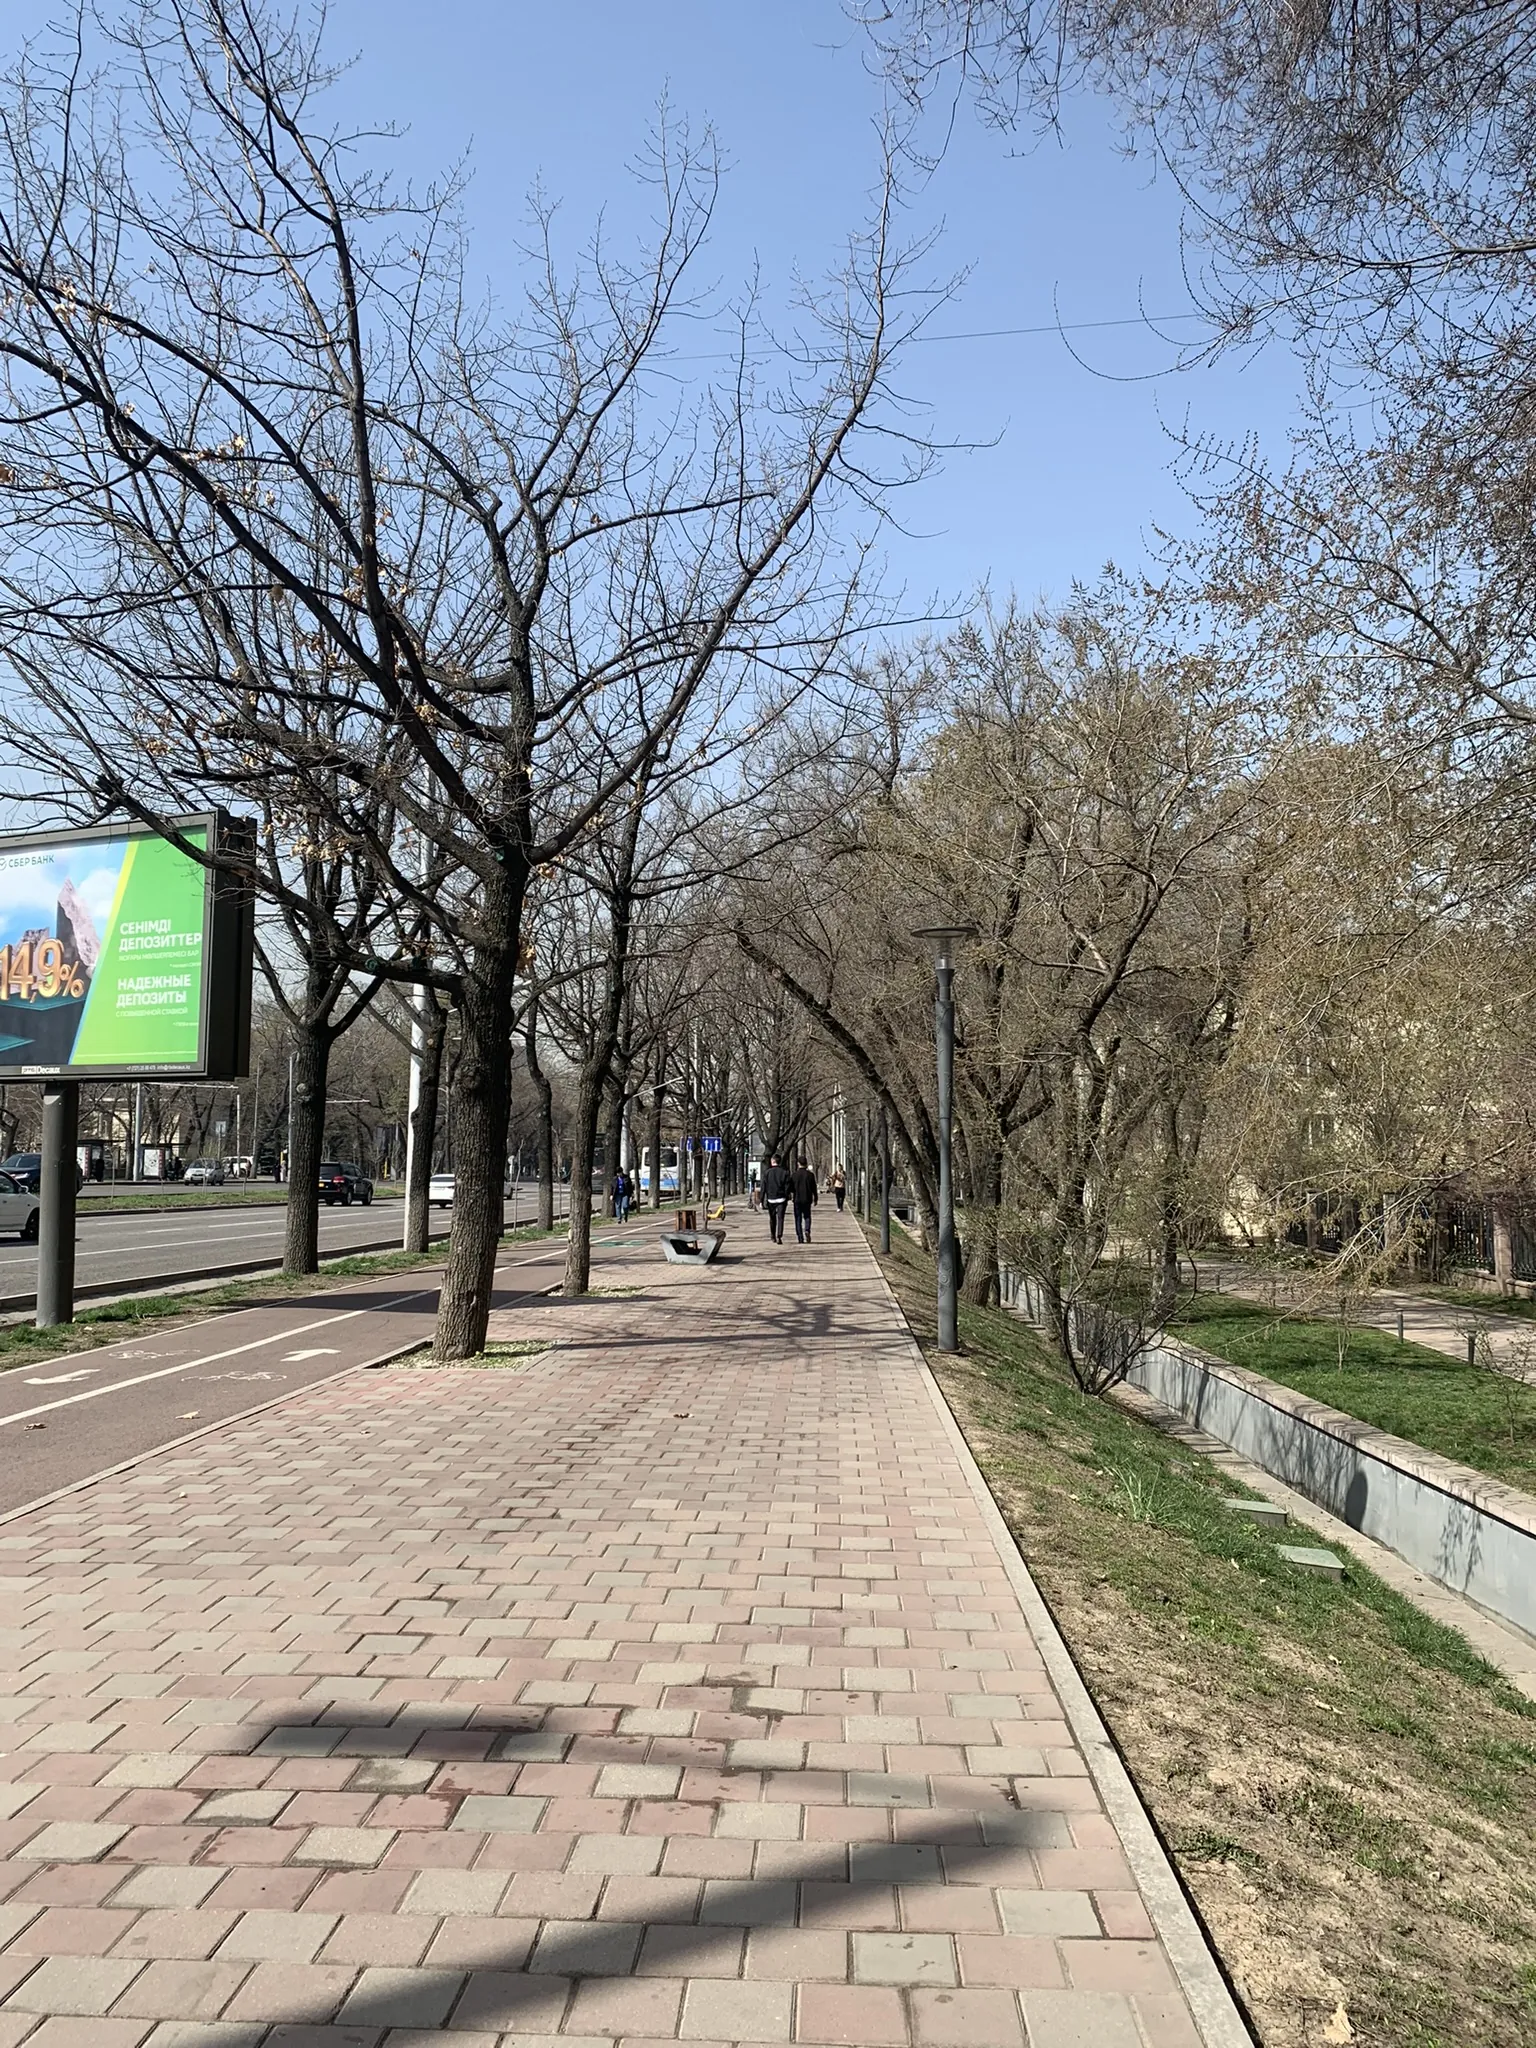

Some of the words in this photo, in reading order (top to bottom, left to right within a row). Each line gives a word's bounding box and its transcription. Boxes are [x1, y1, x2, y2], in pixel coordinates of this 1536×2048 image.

[8, 857, 31, 868] СБЕР
[31, 854, 55, 866] БАНК
[119, 918, 171, 935] СЕНІМДІ
[118, 932, 202, 953] ДЕПОЗИТТЕР
[0, 938, 84, 1004] 14,9%
[117, 974, 192, 991] НАДЕЖНЫЕ
[116, 990, 187, 1008] ДЕПОЗИТЫ
